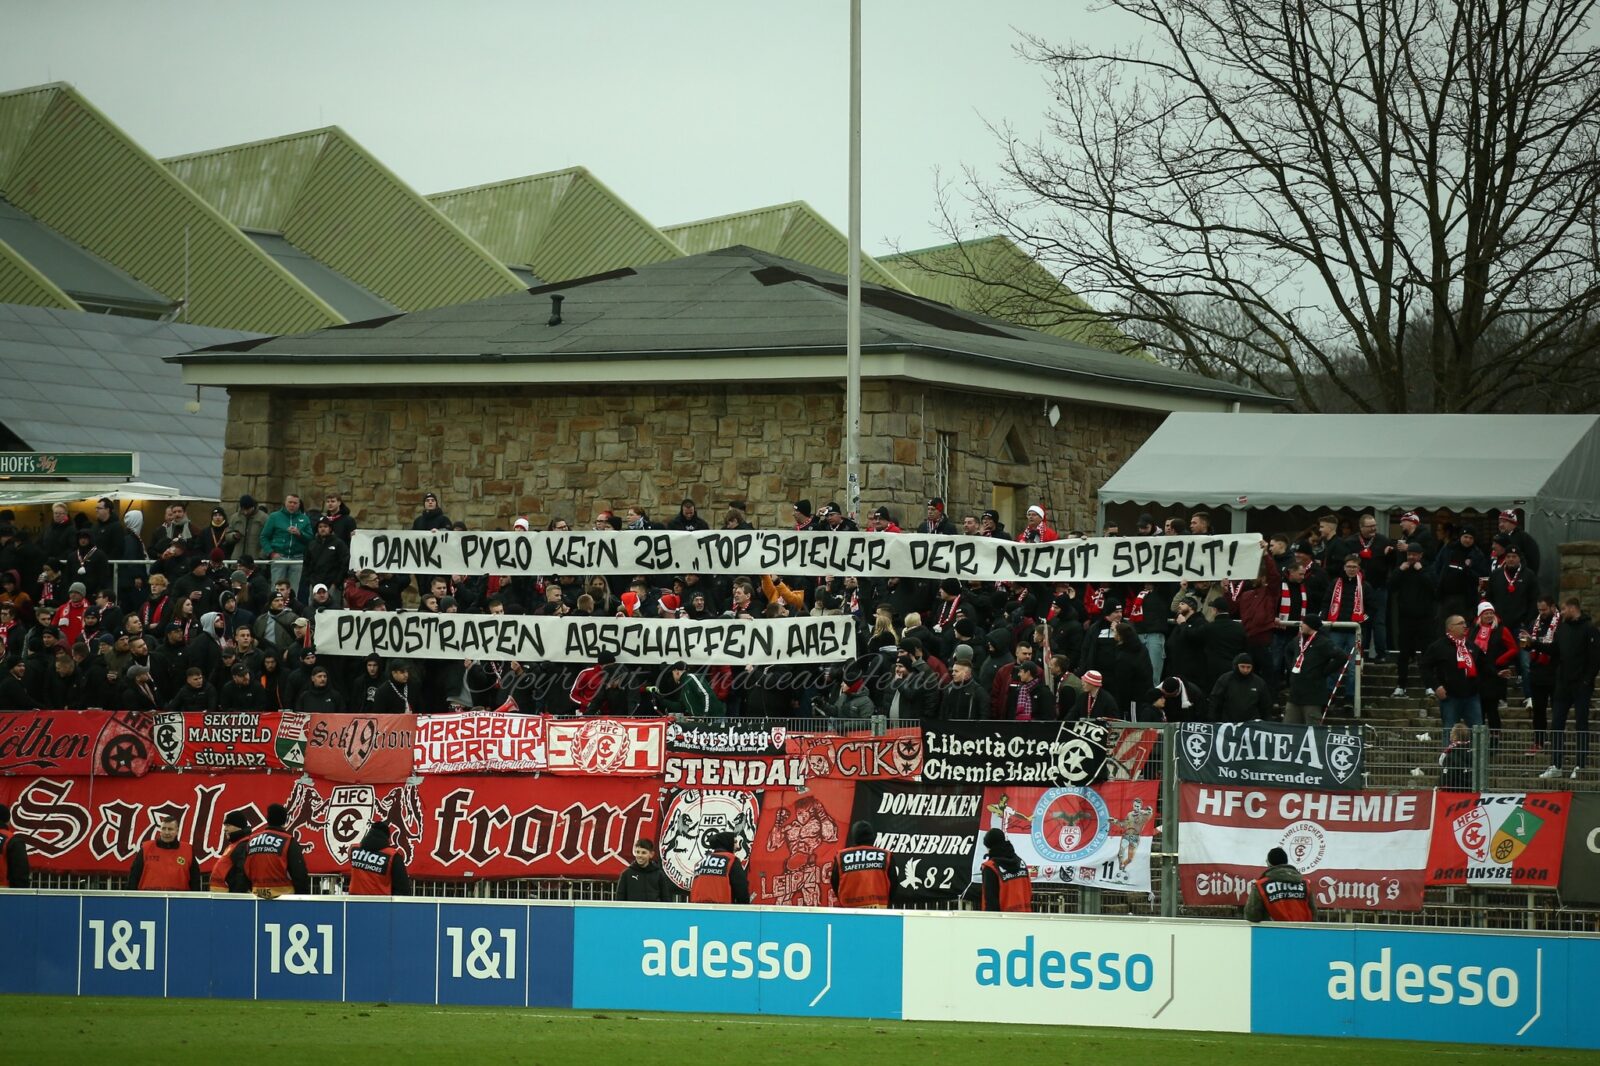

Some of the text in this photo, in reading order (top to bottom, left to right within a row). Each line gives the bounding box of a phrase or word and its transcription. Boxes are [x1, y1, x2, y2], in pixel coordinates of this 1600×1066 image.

[461, 536, 532, 570] PYRO
[546, 536, 618, 569] KEIN
[634, 534, 680, 569] 29.
[910, 540, 978, 574] DER
[993, 545, 1098, 578] NICHT
[1112, 540, 1239, 577] SPIELT!
[338, 615, 544, 657] PYROSTRAFEN
[154, 713, 176, 725] HFC
[204, 714, 259, 726] SEKTION
[600, 725, 618, 735] HFC
[1187, 722, 1208, 734] HFC
[188, 728, 271, 743] MANSFELD
[666, 722, 769, 753] Petersberg
[925, 731, 1005, 757] Libertà
[1332, 735, 1356, 746] HFC
[195, 748, 266, 766] SÜDHARZ
[836, 742, 900, 776] CTK
[665, 758, 805, 786] STENDAL
[923, 758, 1061, 782] Chemie Halle
[1218, 766, 1323, 785] No Surrender
[337, 790, 368, 803] HFC
[877, 793, 981, 817] DOMFALKEN
[1197, 789, 1417, 822] HFC CHEMIE
[431, 787, 654, 867] front
[704, 817, 723, 825] HFC
[1457, 809, 1480, 828] HFC
[873, 832, 975, 856] MERSEBURG
[352, 849, 387, 866] atlas
[843, 851, 885, 863] atlas
[844, 863, 865, 872] SAFETY
[1102, 860, 1114, 879] 11
[1433, 866, 1549, 881] BRAUNSBEDRA
[89, 919, 156, 971] 1&1
[264, 923, 333, 975] 1&1
[446, 927, 516, 979] 1&1
[641, 925, 811, 980] adesso
[975, 935, 1154, 992] adesso
[1327, 947, 1519, 1008] adesso
